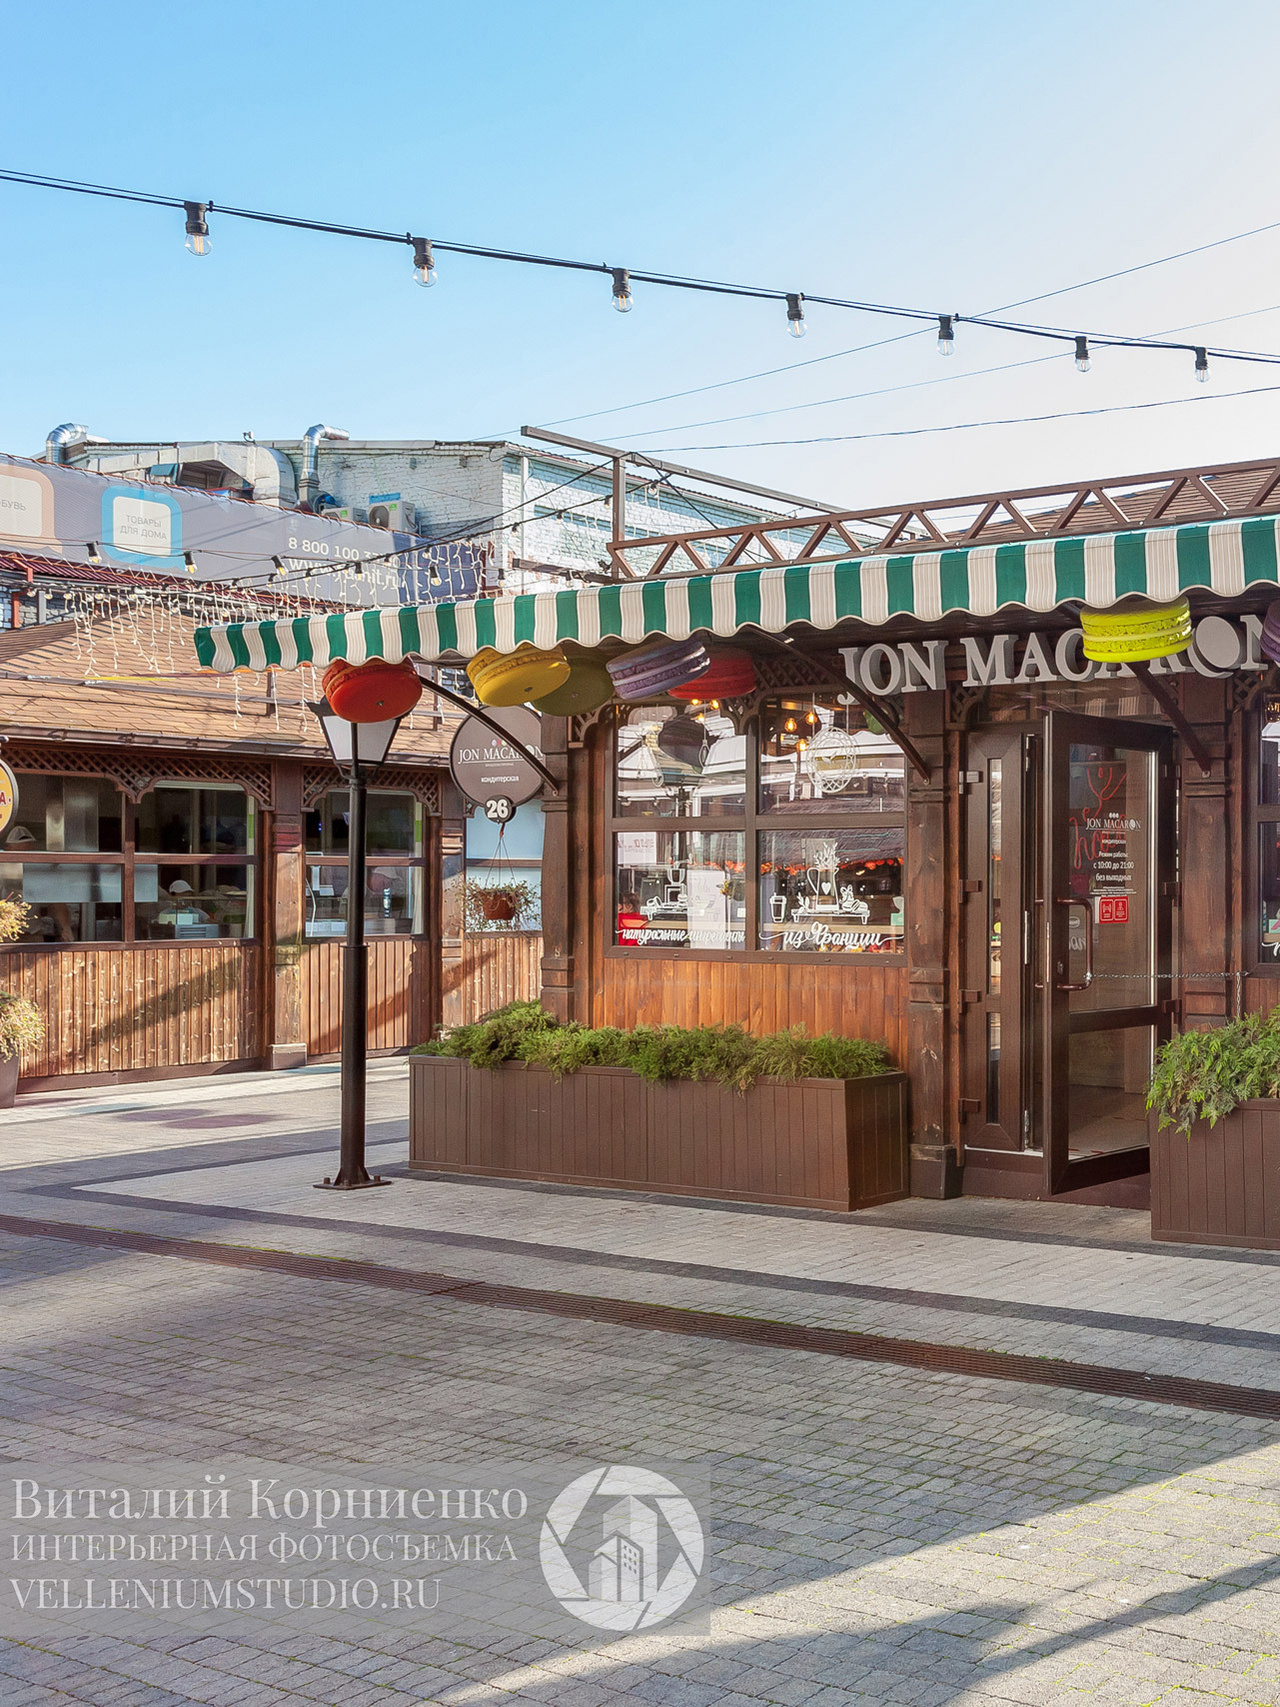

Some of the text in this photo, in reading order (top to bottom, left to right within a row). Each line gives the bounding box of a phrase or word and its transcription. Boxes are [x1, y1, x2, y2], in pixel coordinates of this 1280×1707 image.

[0, 500, 27, 512] БУВЬ
[126, 514, 162, 528] ТОВАРЫ
[119, 524, 168, 541] ДЛЯ ДОМА
[288, 537, 298, 550] 8
[302, 540, 329, 556] 800
[334, 545, 360, 561] 100
[837, 614, 1270, 706] JON MACON
[458, 747, 480, 765] JON
[486, 799, 509, 819] 26
[1085, 818, 1142, 831] JON MACARON
[1097, 860, 1112, 869] 10:00
[1112, 862, 1120, 870] до
[1120, 860, 1135, 869] 21:00
[1095, 872, 1106, 881] без
[617, 928, 686, 945] натуральные
[803, 921, 890, 947] Франции
